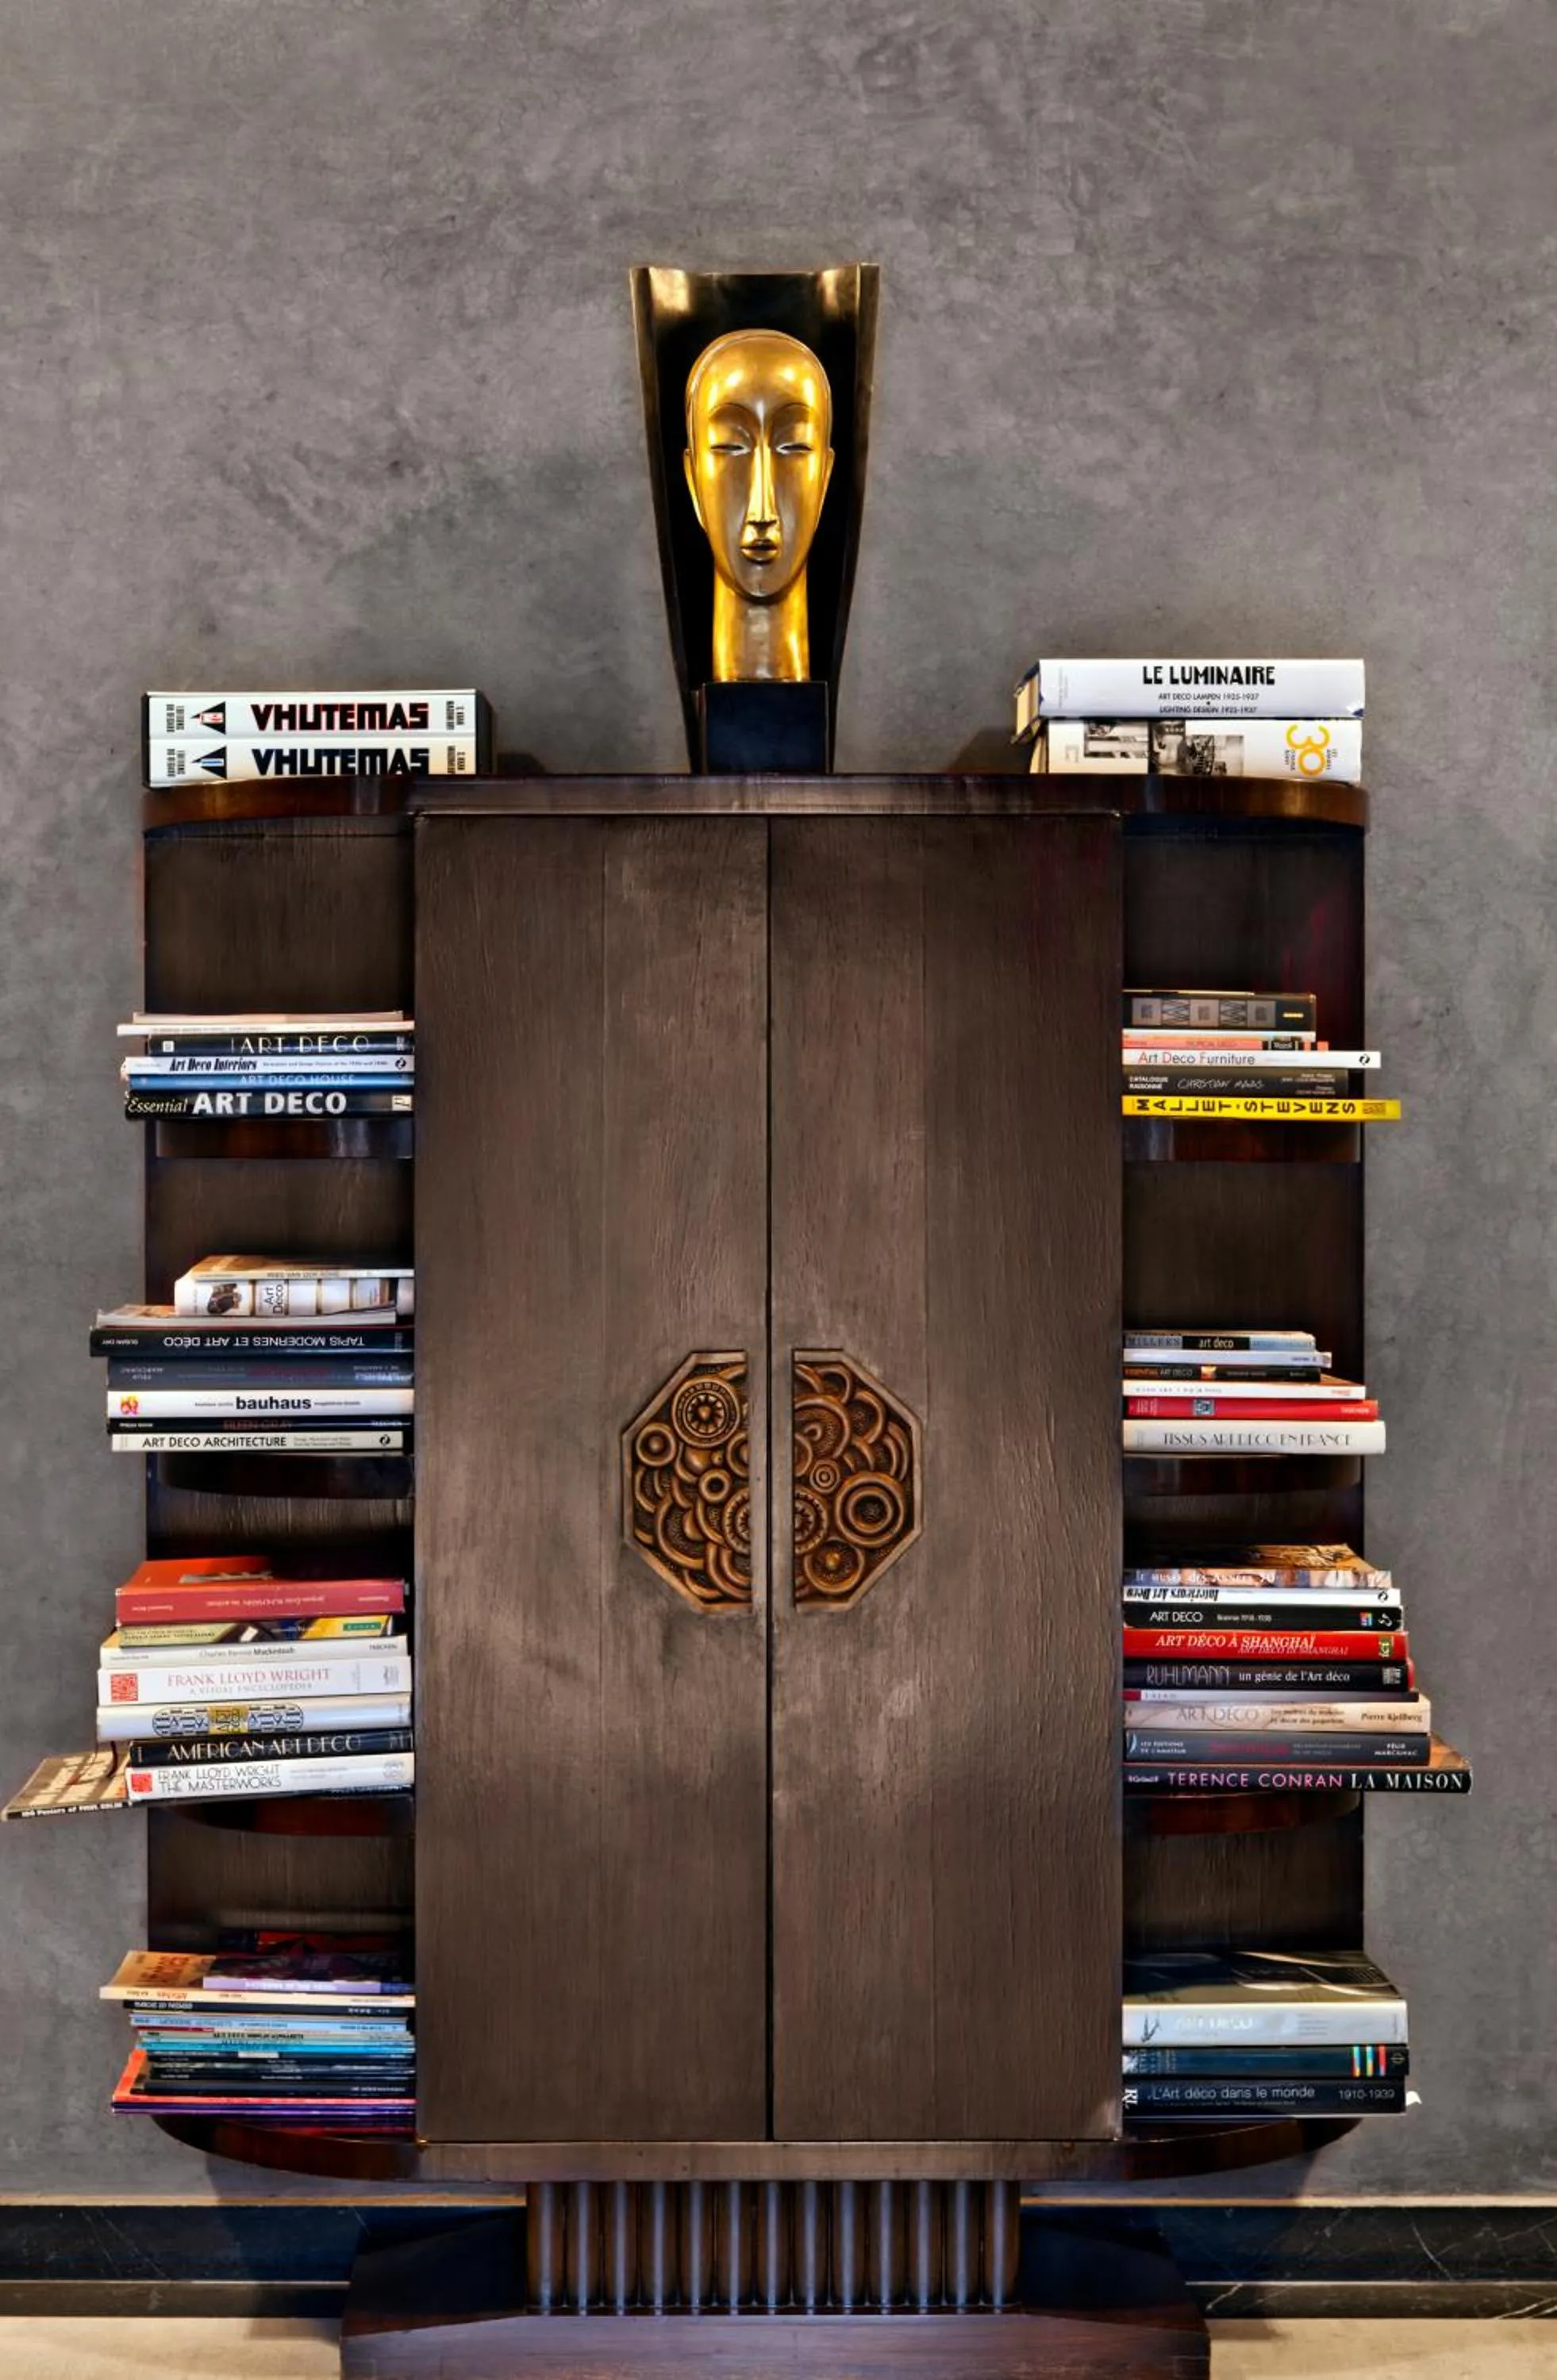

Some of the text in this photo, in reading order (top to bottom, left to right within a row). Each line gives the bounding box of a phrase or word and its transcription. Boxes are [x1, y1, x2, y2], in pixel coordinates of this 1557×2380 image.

[1143, 666, 1275, 685] LE LUMINAIRE
[251, 703, 429, 731] VHUTEMAS
[252, 747, 430, 777] VHUTEMAS
[240, 1035, 370, 1054] ART DECO
[169, 1059, 186, 1071] Art
[187, 1059, 212, 1071] Deco
[213, 1058, 257, 1072] Interiors
[1138, 1052, 1255, 1065] Art Deco Furniture
[240, 1076, 264, 1086] ART
[269, 1075, 306, 1087] DECO
[128, 1097, 188, 1113] Essential
[192, 1092, 347, 1115] ART DECO
[1136, 1098, 1356, 1115] MALLET-STEVENS
[265, 1284, 274, 1305] Art
[163, 1336, 366, 1348] TAPIS MODERNES ET ART DÉCO
[1198, 1337, 1234, 1349] art deco
[236, 1397, 311, 1410] bauhaus
[142, 1438, 165, 1448] ART
[168, 1438, 200, 1448] DECO
[203, 1437, 286, 1447] ARCHITECTURE
[1153, 1588, 1169, 1599] Art
[1150, 1611, 1203, 1622] ART DECO
[1155, 1635, 1185, 1646] ART
[1186, 1633, 1226, 1647] DÉCO
[167, 1668, 330, 1687] FRANK LLOYD WRIGHT
[1147, 1664, 1229, 1686] RUHLMANN
[1255, 1671, 1282, 1683] génie
[1285, 1672, 1298, 1681] de
[1301, 1672, 1323, 1681] l'Art
[1326, 1670, 1350, 1681] déco
[1177, 1708, 1206, 1721] ART
[167, 1741, 263, 1760] AMERICAN
[159, 1770, 190, 1780] FRANK
[196, 1767, 232, 1779] LLOYD
[236, 1764, 281, 1777] WRIGHT
[160, 1775, 282, 1794] THE MASTERWORKS
[1168, 1773, 1249, 1787] TERENCE
[1258, 1773, 1343, 1787] CONRAN
[1351, 1773, 1375, 1789] LA
[1386, 1772, 1463, 1789] MAISON
[1153, 2086, 1315, 2100] L'Art déco dans le monde
